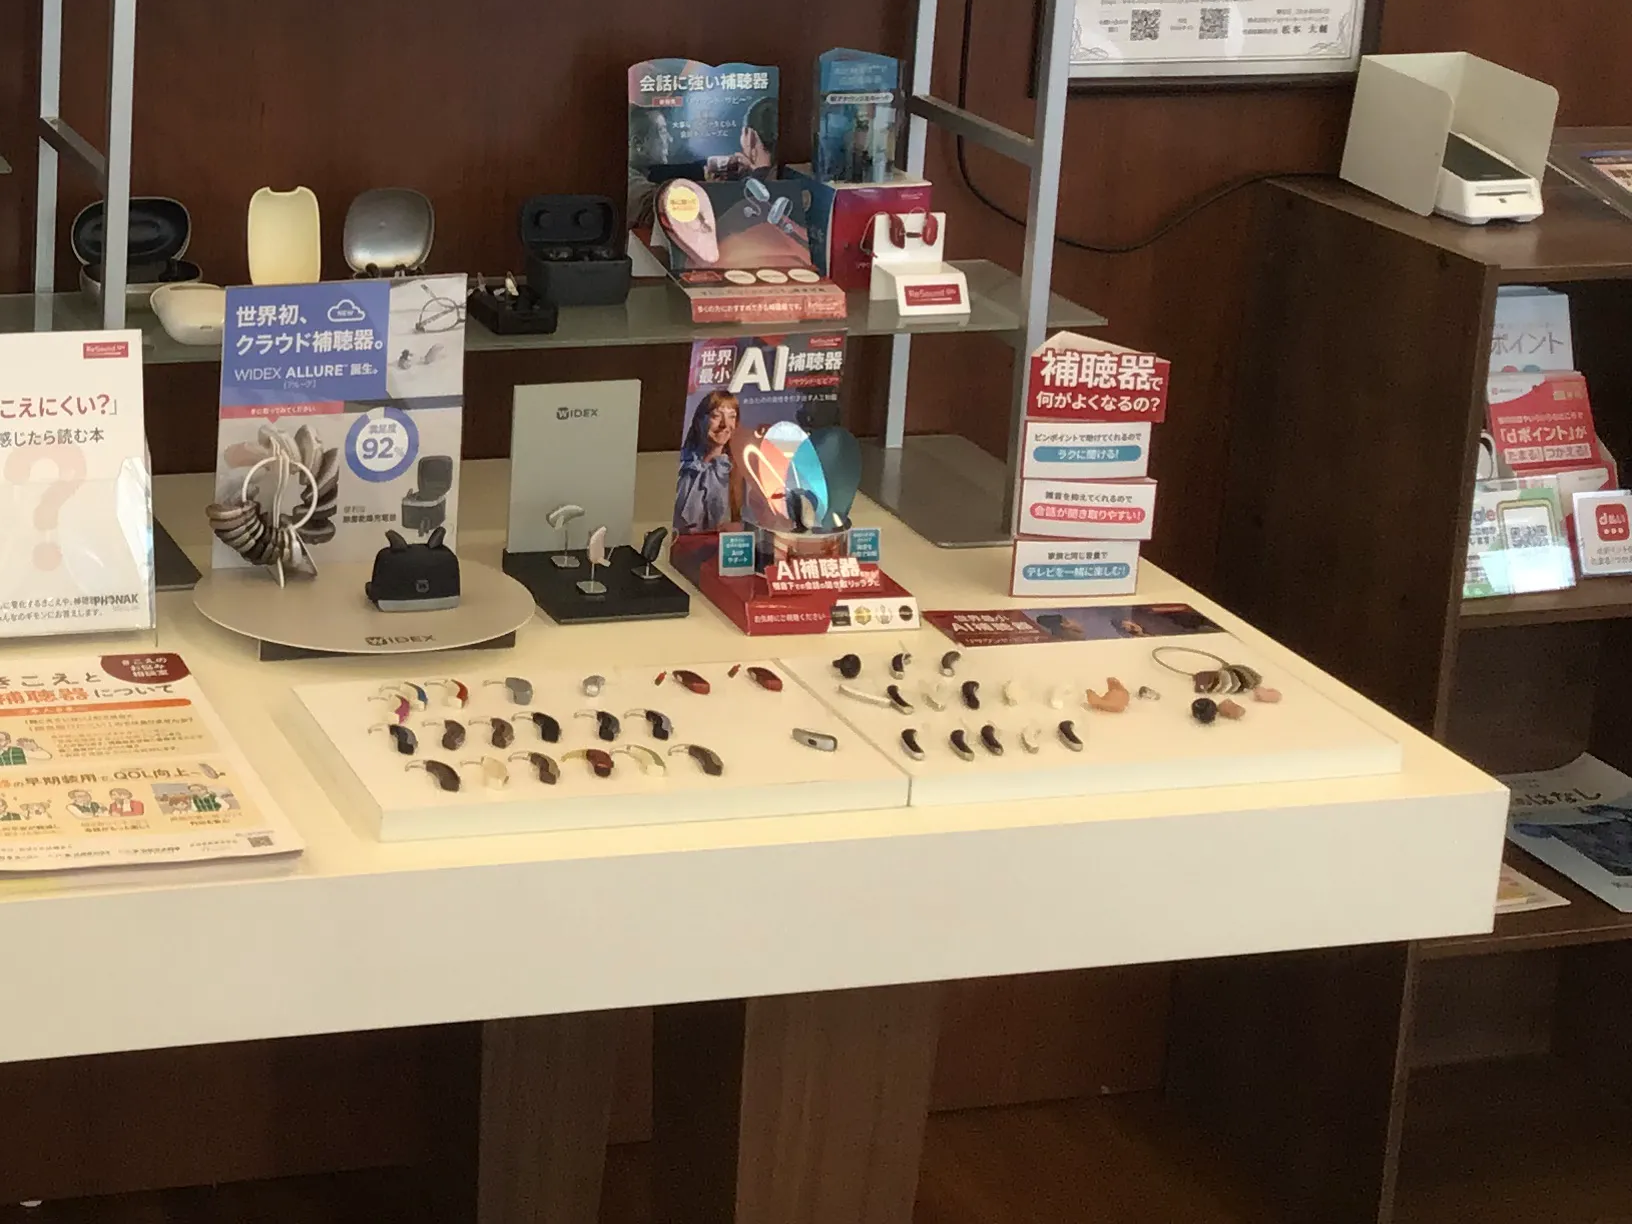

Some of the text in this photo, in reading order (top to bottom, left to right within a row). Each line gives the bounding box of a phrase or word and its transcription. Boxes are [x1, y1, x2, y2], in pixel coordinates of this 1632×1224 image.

[639, 72, 769, 92] 会話に強い補聴器
[236, 304, 308, 328] 世界初、
[236, 329, 384, 356] クラウド補聴器。
[701, 349, 732, 366] 世界
[234, 366, 282, 382] WIDEX
[728, 345, 843, 393] AI 補聴器
[1040, 350, 1164, 392] 補聴器で
[1036, 391, 1161, 413] 何がよくなるの?
[1035, 506, 1143, 521] 会話が聞き取りやすい!
[777, 558, 861, 581] AI補聴器
